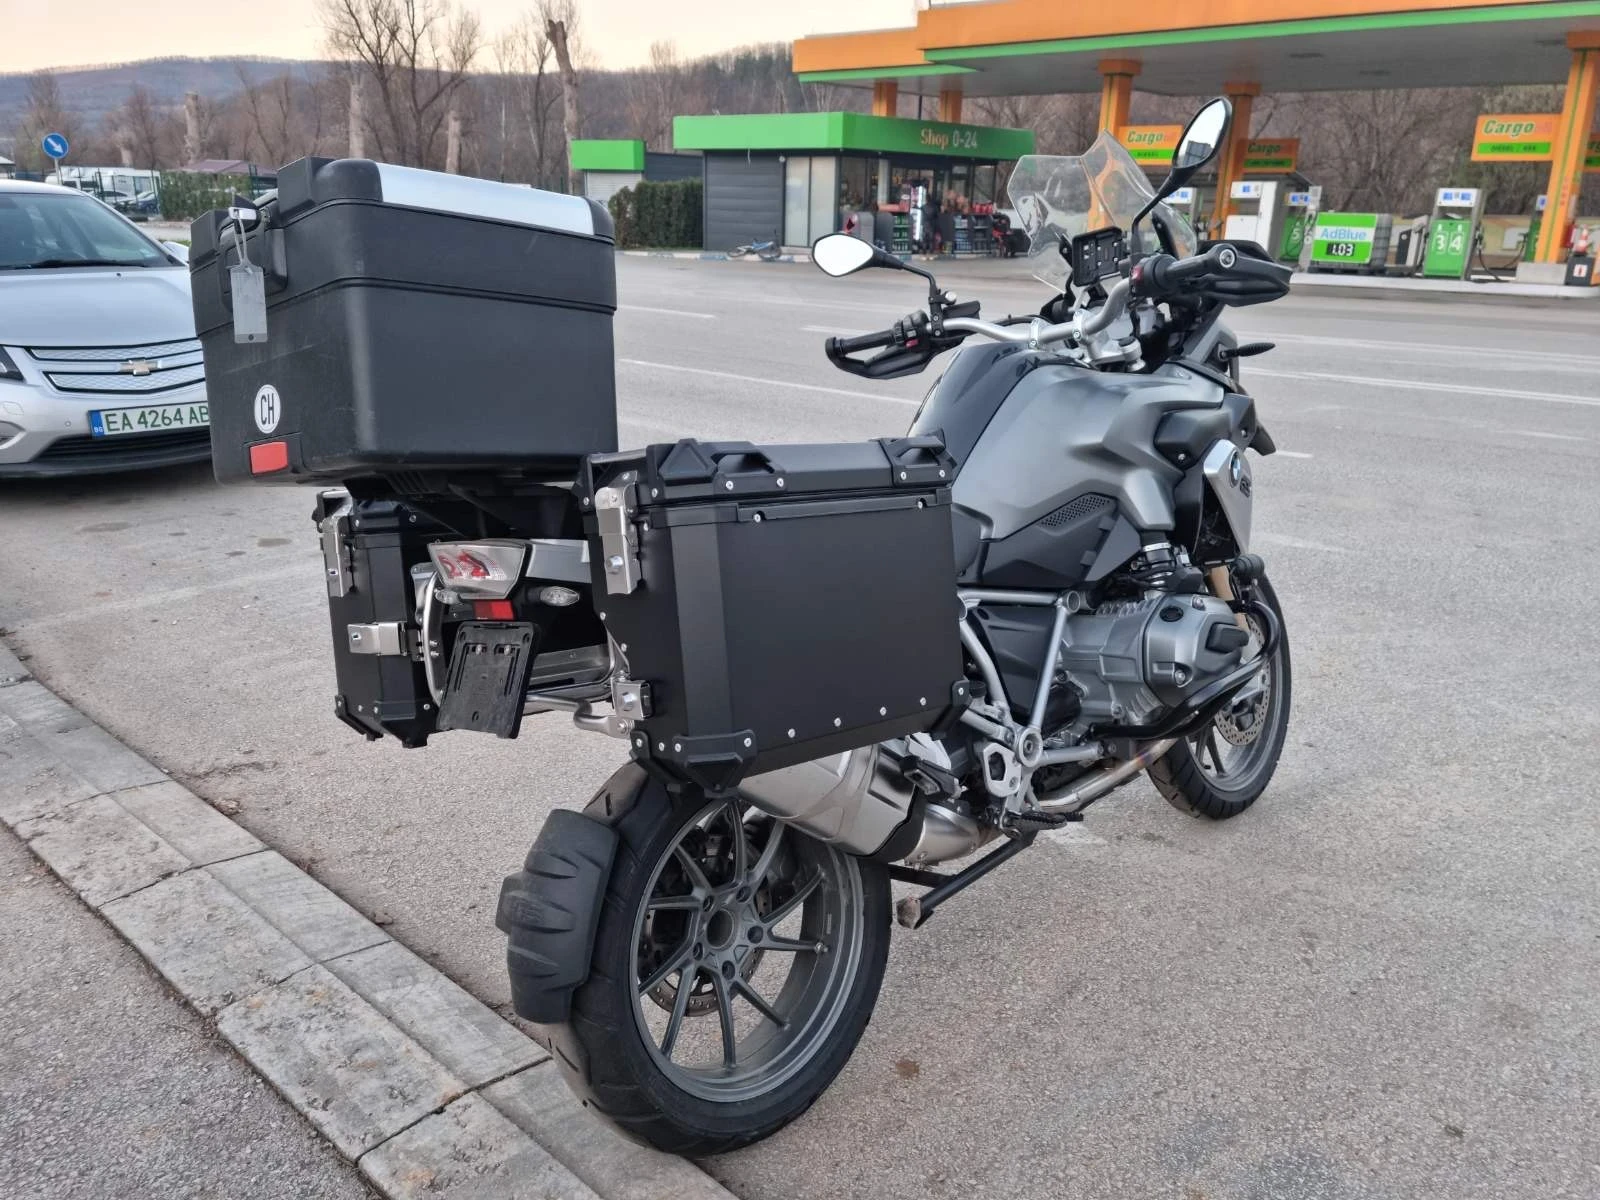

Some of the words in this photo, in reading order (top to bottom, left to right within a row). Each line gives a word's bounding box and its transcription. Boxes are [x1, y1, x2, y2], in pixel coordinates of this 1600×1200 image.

[1127, 130, 1164, 146] Cargo
[1482, 119, 1535, 139] Cargo
[920, 127, 949, 150] Shop
[952, 129, 977, 148] 0-24
[1291, 228, 1301, 241] 5
[1320, 228, 1367, 241] AdBlue
[1436, 234, 1446, 250] 3
[1450, 234, 1462, 250] 4
[260, 392, 275, 425] CH
[104, 412, 134, 432] EA
[137, 407, 184, 429] 4264
[189, 405, 210, 425] AB
